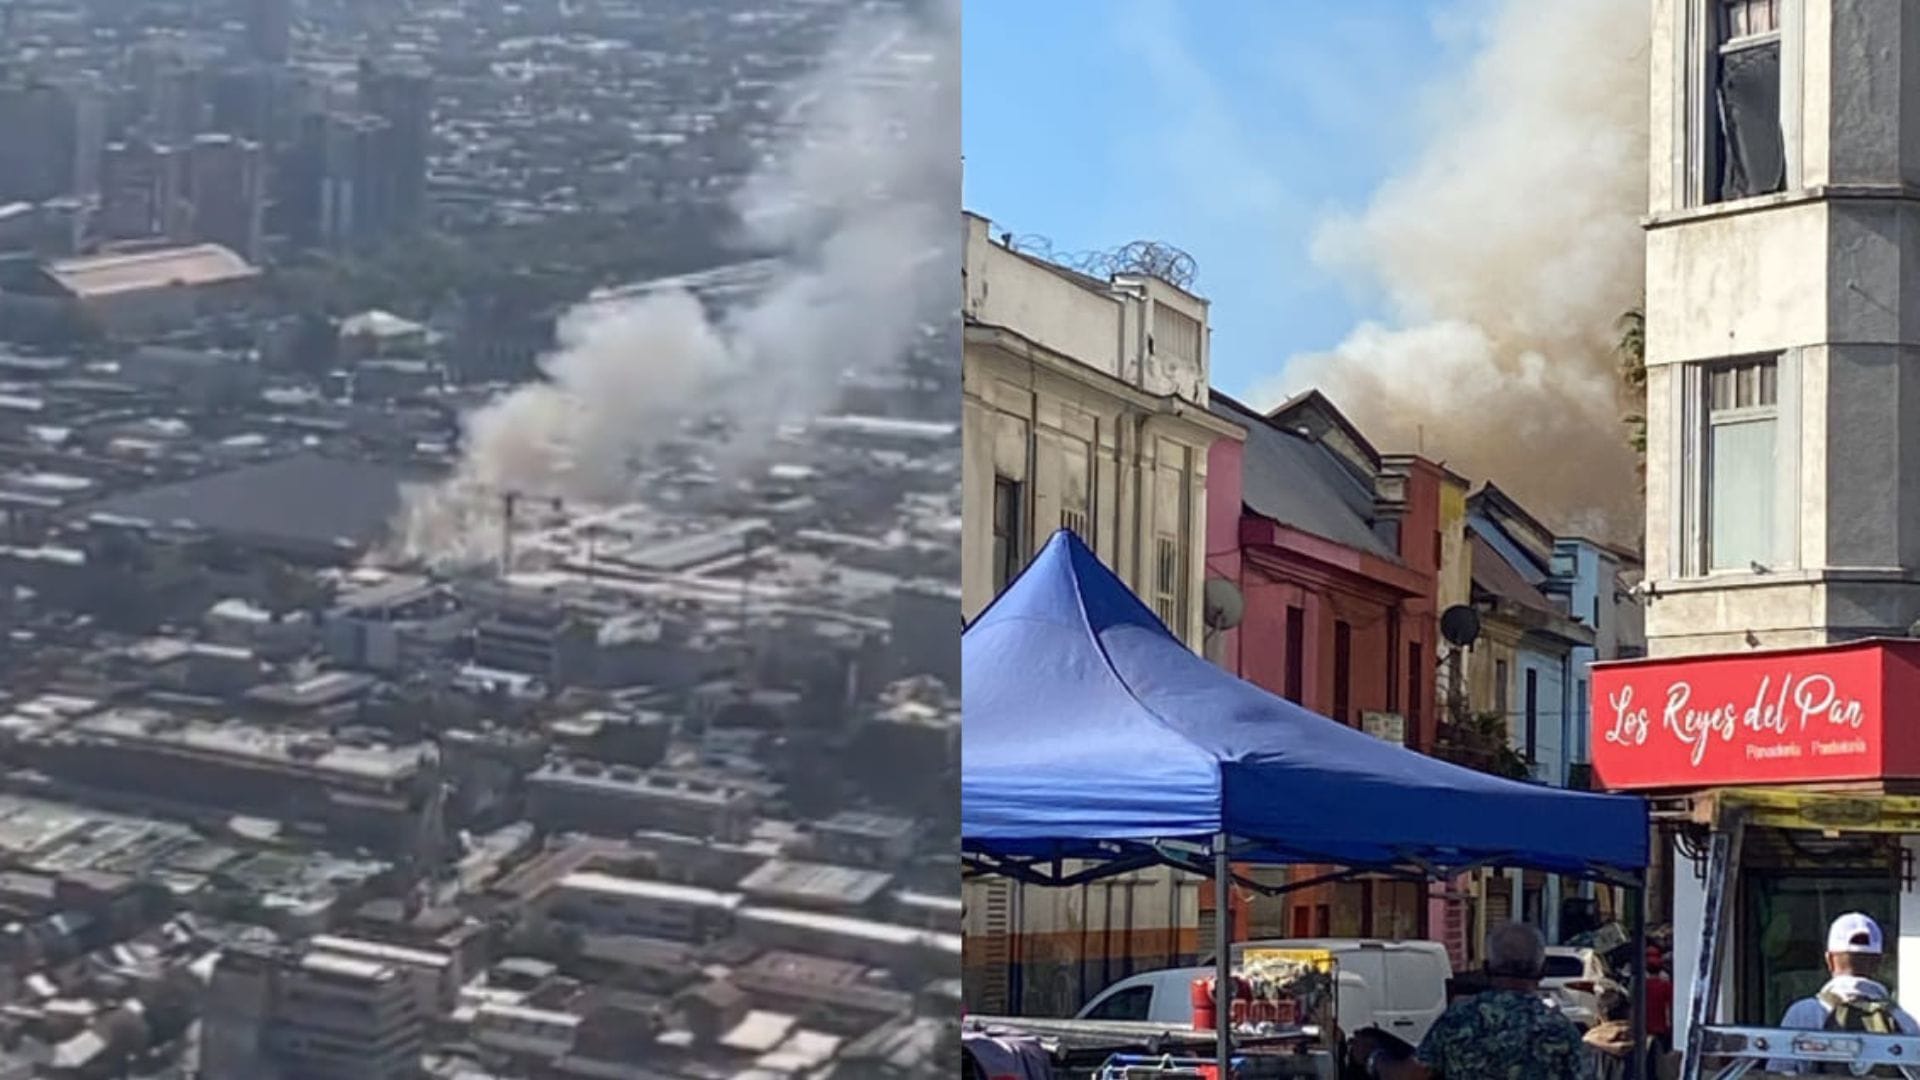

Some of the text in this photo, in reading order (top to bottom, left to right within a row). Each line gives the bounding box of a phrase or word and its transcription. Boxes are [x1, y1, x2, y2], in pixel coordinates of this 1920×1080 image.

[1605, 673, 1863, 766] Los Reyes del Pan
